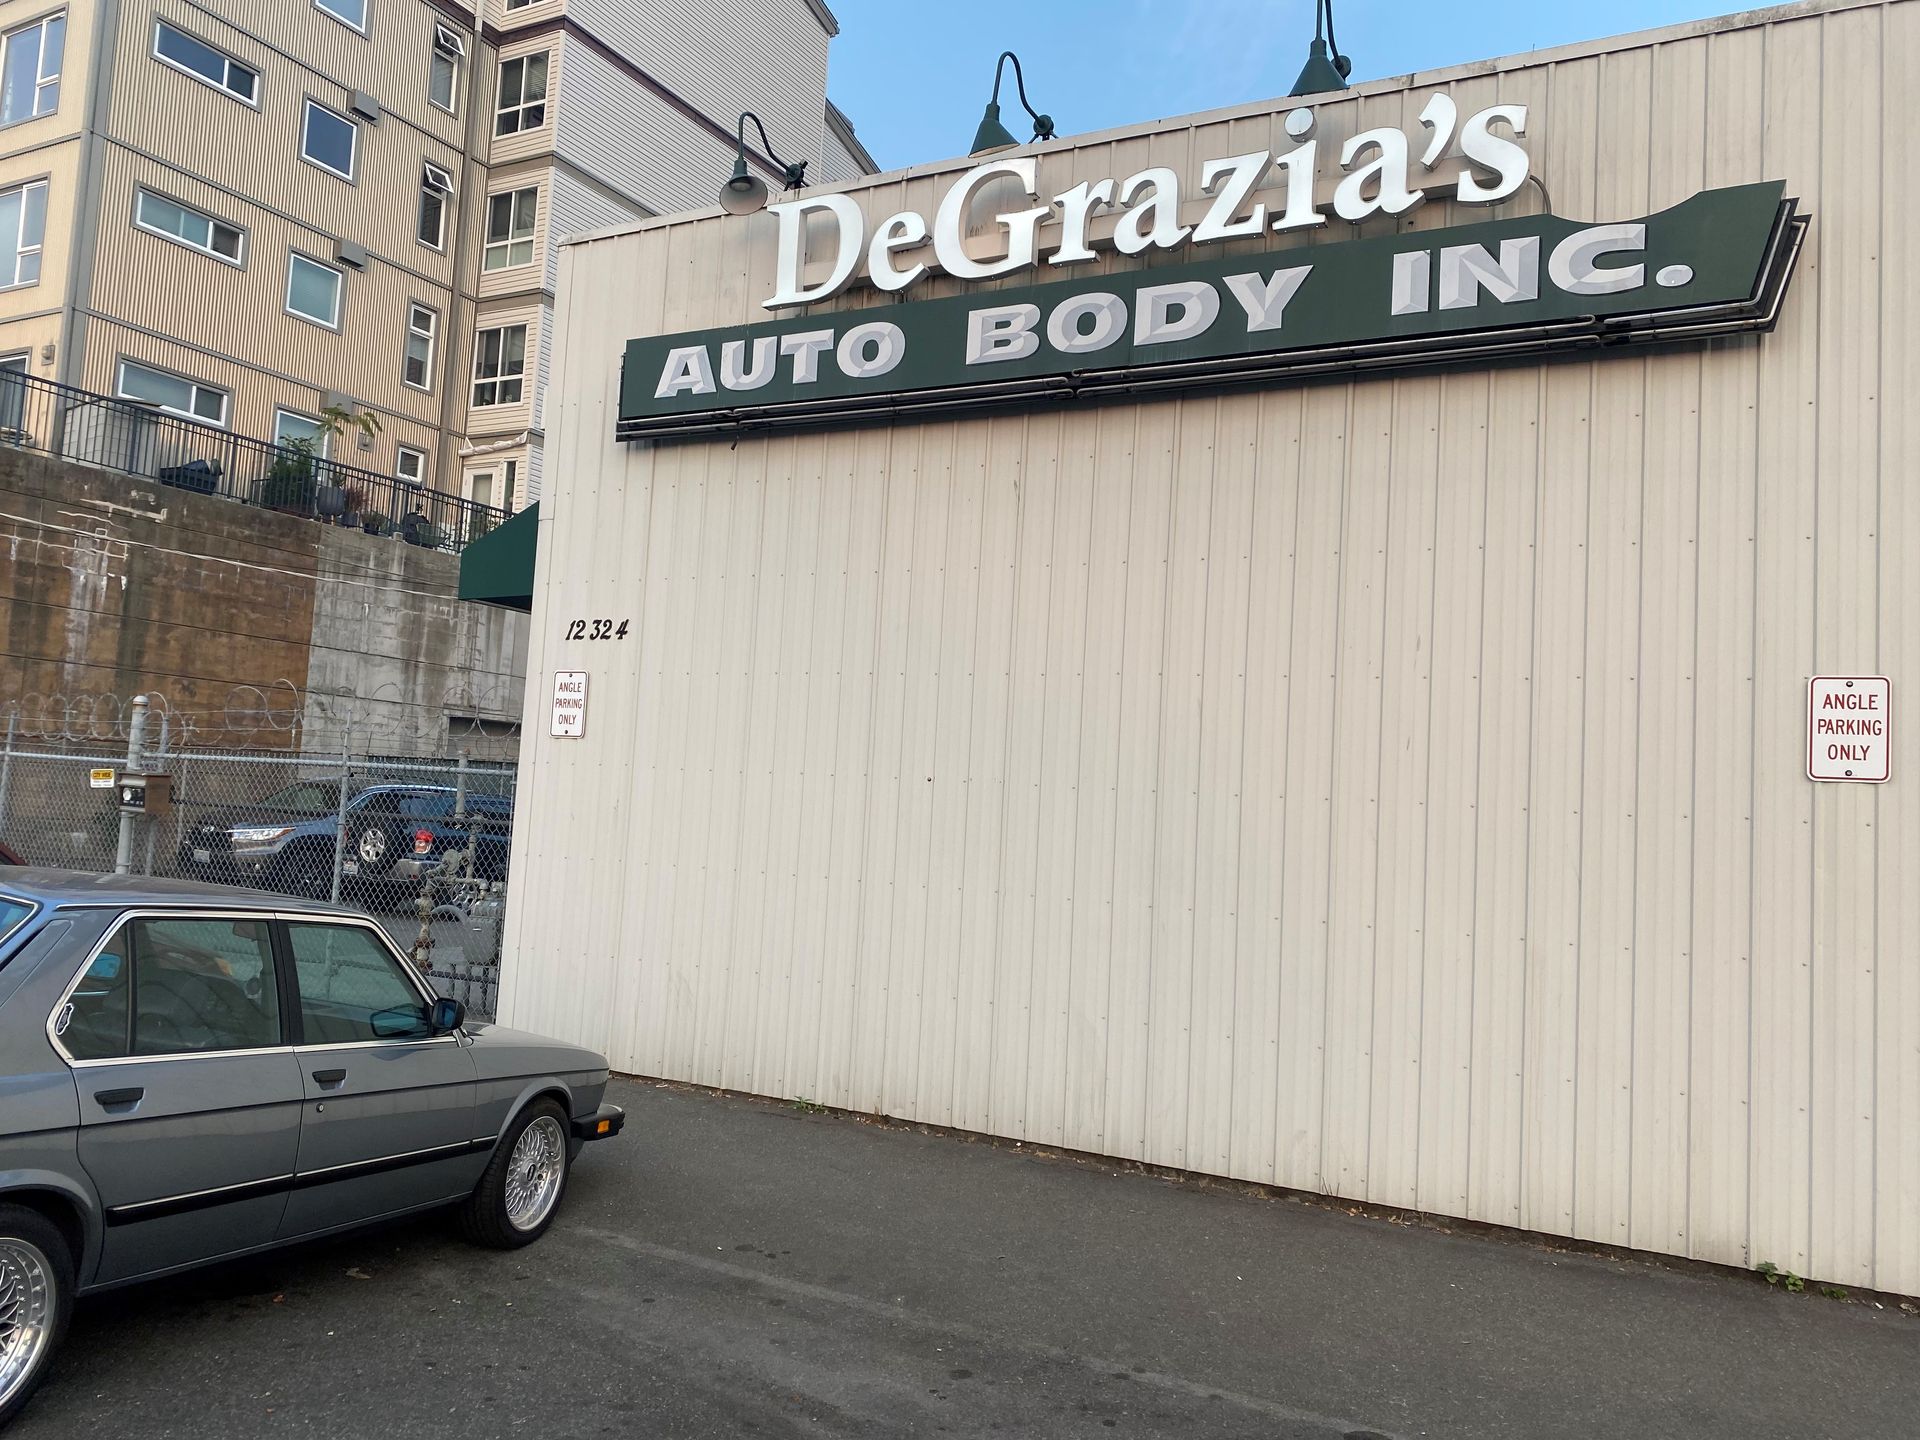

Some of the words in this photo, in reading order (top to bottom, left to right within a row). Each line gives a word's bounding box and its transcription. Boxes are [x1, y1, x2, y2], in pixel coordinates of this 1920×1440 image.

[761, 91, 1531, 311] DeGrazia's
[654, 321, 906, 399] AUTO
[965, 264, 1314, 366] BODY
[1391, 223, 1694, 317] INC.
[558, 681, 583, 693] ANGLE
[555, 697, 583, 709] PARKING
[1822, 693, 1879, 710] ANGLE
[558, 713, 577, 725] ONLY
[1817, 718, 1882, 736] PARKING
[1827, 743, 1871, 761] ONLY
